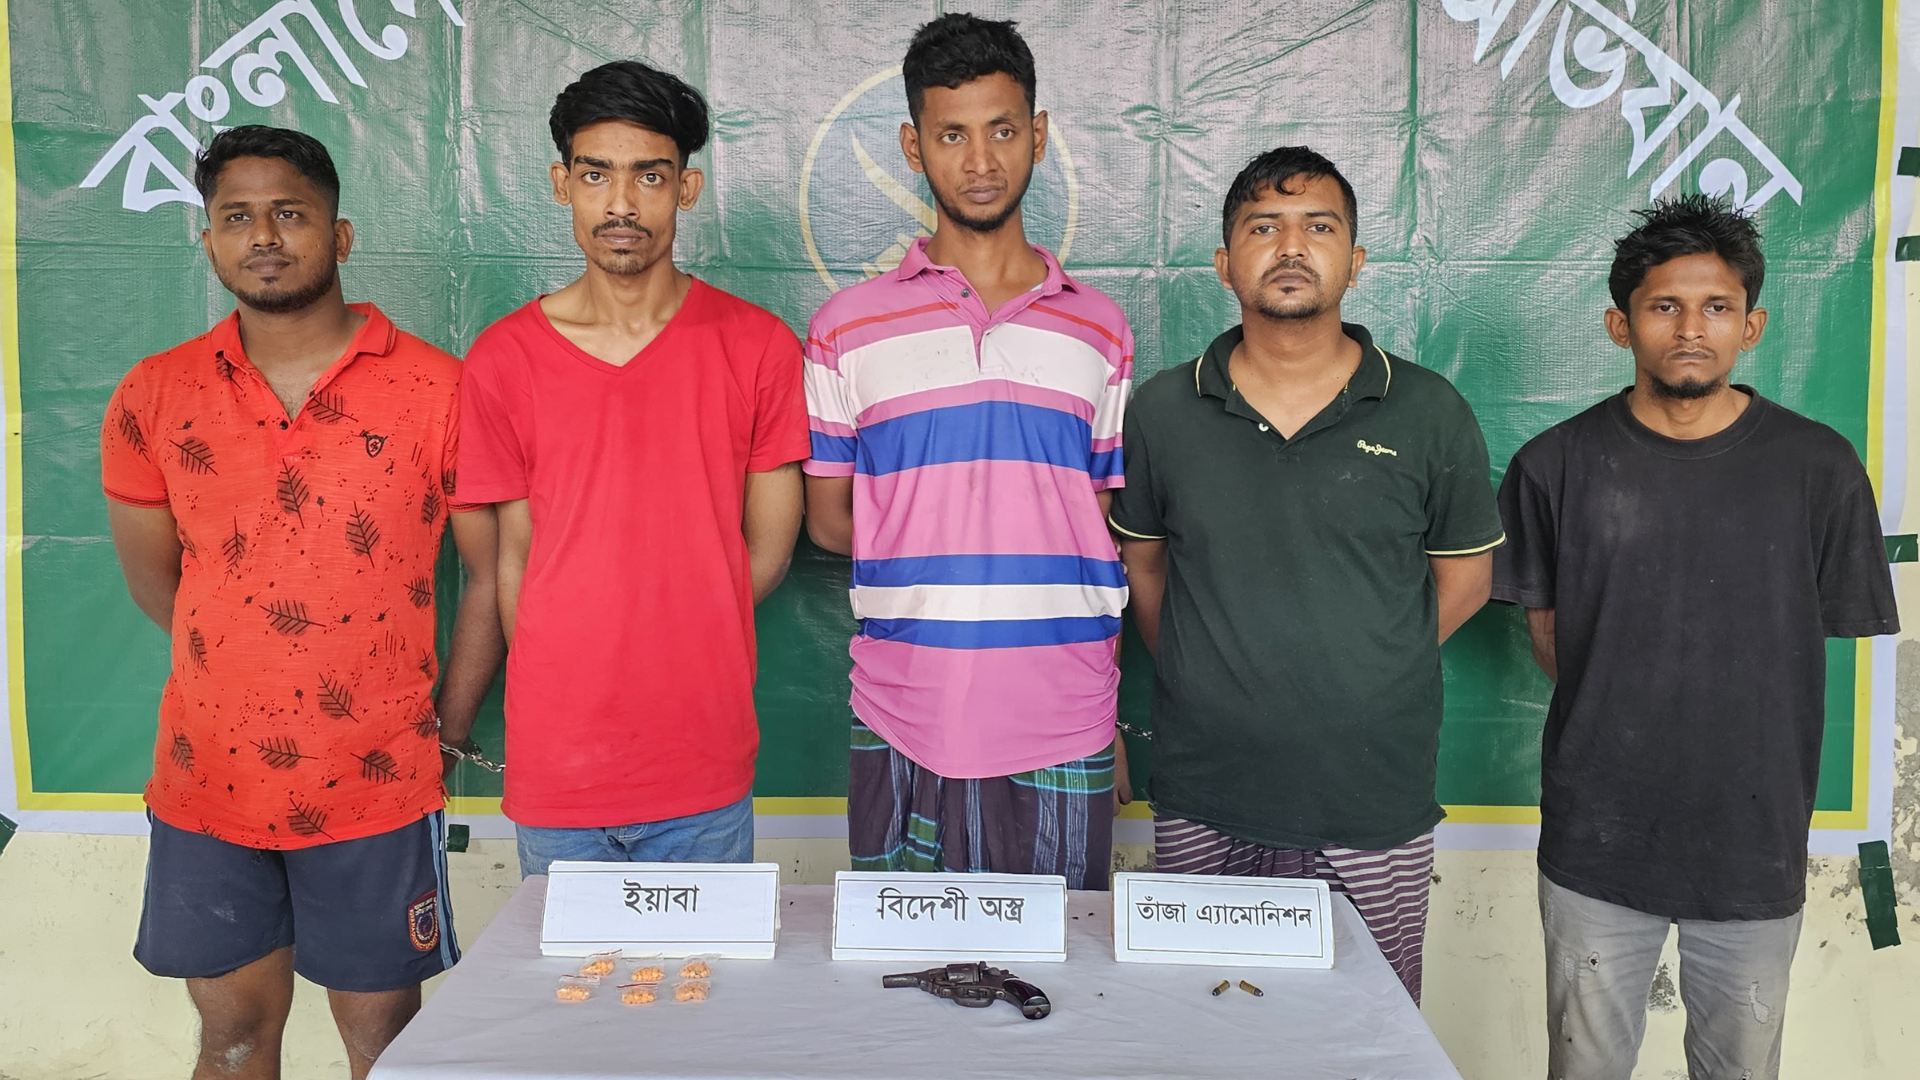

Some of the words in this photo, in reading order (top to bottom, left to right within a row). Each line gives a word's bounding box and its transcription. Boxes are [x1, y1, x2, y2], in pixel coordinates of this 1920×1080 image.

[622, 878, 700, 915] ইয়াবা
[876, 887, 970, 921] বিদেশী
[977, 896, 1025, 924] অস্ত্র
[1135, 895, 1187, 923] তাঁজা
[1196, 900, 1313, 929] এ্যামোনিশন
